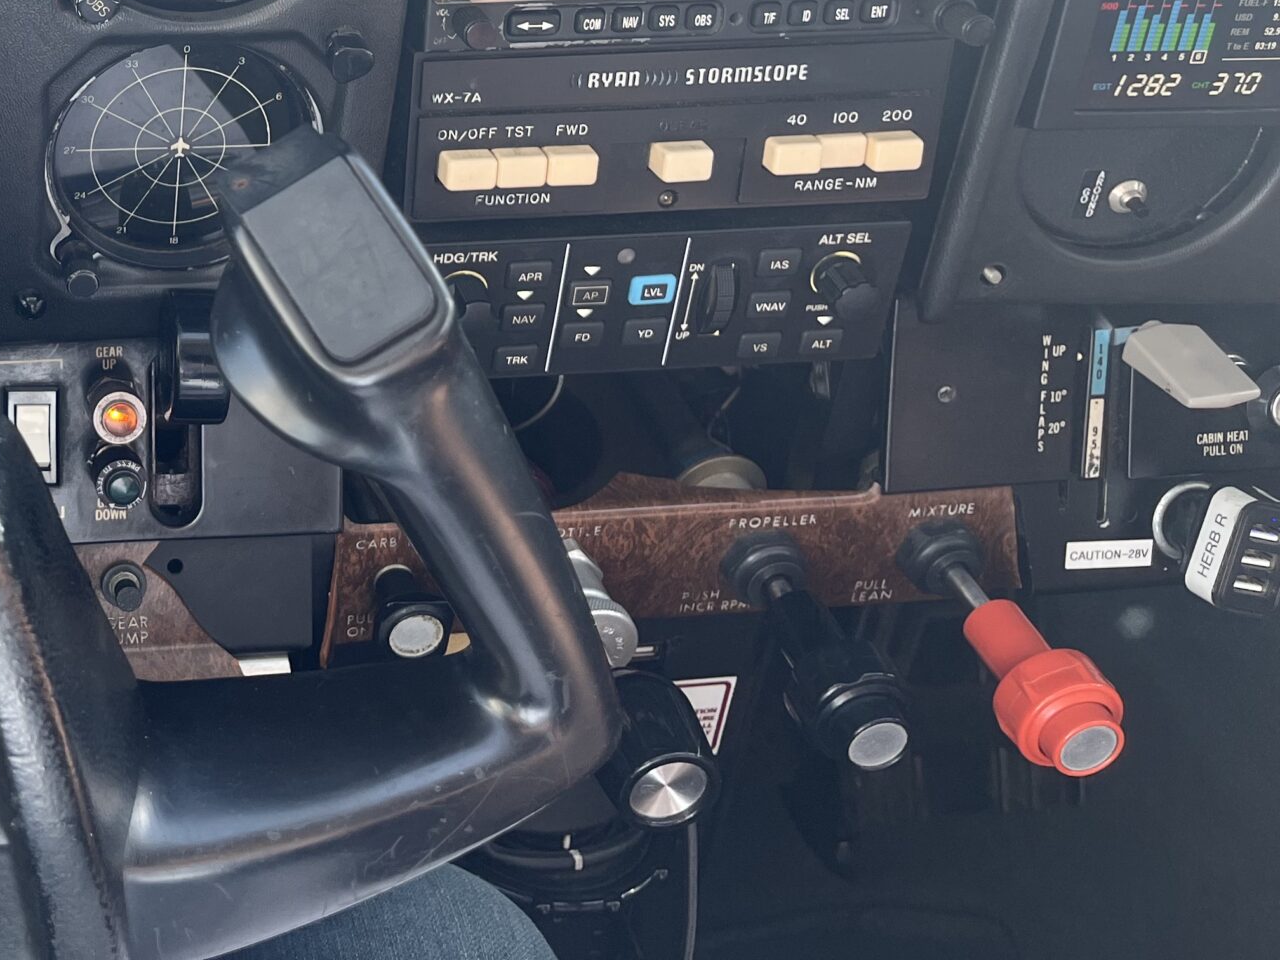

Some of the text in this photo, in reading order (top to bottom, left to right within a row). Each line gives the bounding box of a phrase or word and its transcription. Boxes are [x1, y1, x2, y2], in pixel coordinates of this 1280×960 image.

[835, 8, 850, 20] SEL
[871, 6, 887, 18] ENT
[583, 19, 601, 30] COM
[622, 16, 639, 28] NAV
[658, 14, 675, 27] SYS
[694, 14, 712, 26] OBS
[588, 64, 808, 88] RYAN STORMSCOPE
[1113, 73, 1181, 97] 1282
[1208, 72, 1262, 96] 370
[432, 91, 482, 104] WX-7A
[787, 113, 807, 126] 40
[832, 112, 859, 124] 100
[882, 109, 913, 122] 200
[437, 125, 498, 140] ON/OFF
[505, 126, 534, 138] TST
[555, 124, 589, 136] FWD
[475, 192, 551, 206] FUNCTION
[819, 232, 871, 245] ALT SEL
[433, 251, 498, 265] HDG/TRK
[770, 260, 790, 269] IAS
[518, 271, 543, 282] APR
[755, 301, 786, 312] VNAV
[512, 315, 536, 325] NAV
[811, 339, 832, 349] ALT
[95, 346, 123, 359] GEAR
[506, 355, 528, 365] TRK
[1196, 430, 1249, 446] CABIN HEAT
[1203, 443, 1243, 456] PULL ON
[95, 508, 127, 521] DOWN
[909, 502, 976, 519] MIXTURE
[728, 513, 817, 530] PROPELLER
[1070, 548, 1149, 561] CAUTION-28V
[854, 580, 887, 593] PULL
[850, 589, 893, 602] LEAN
